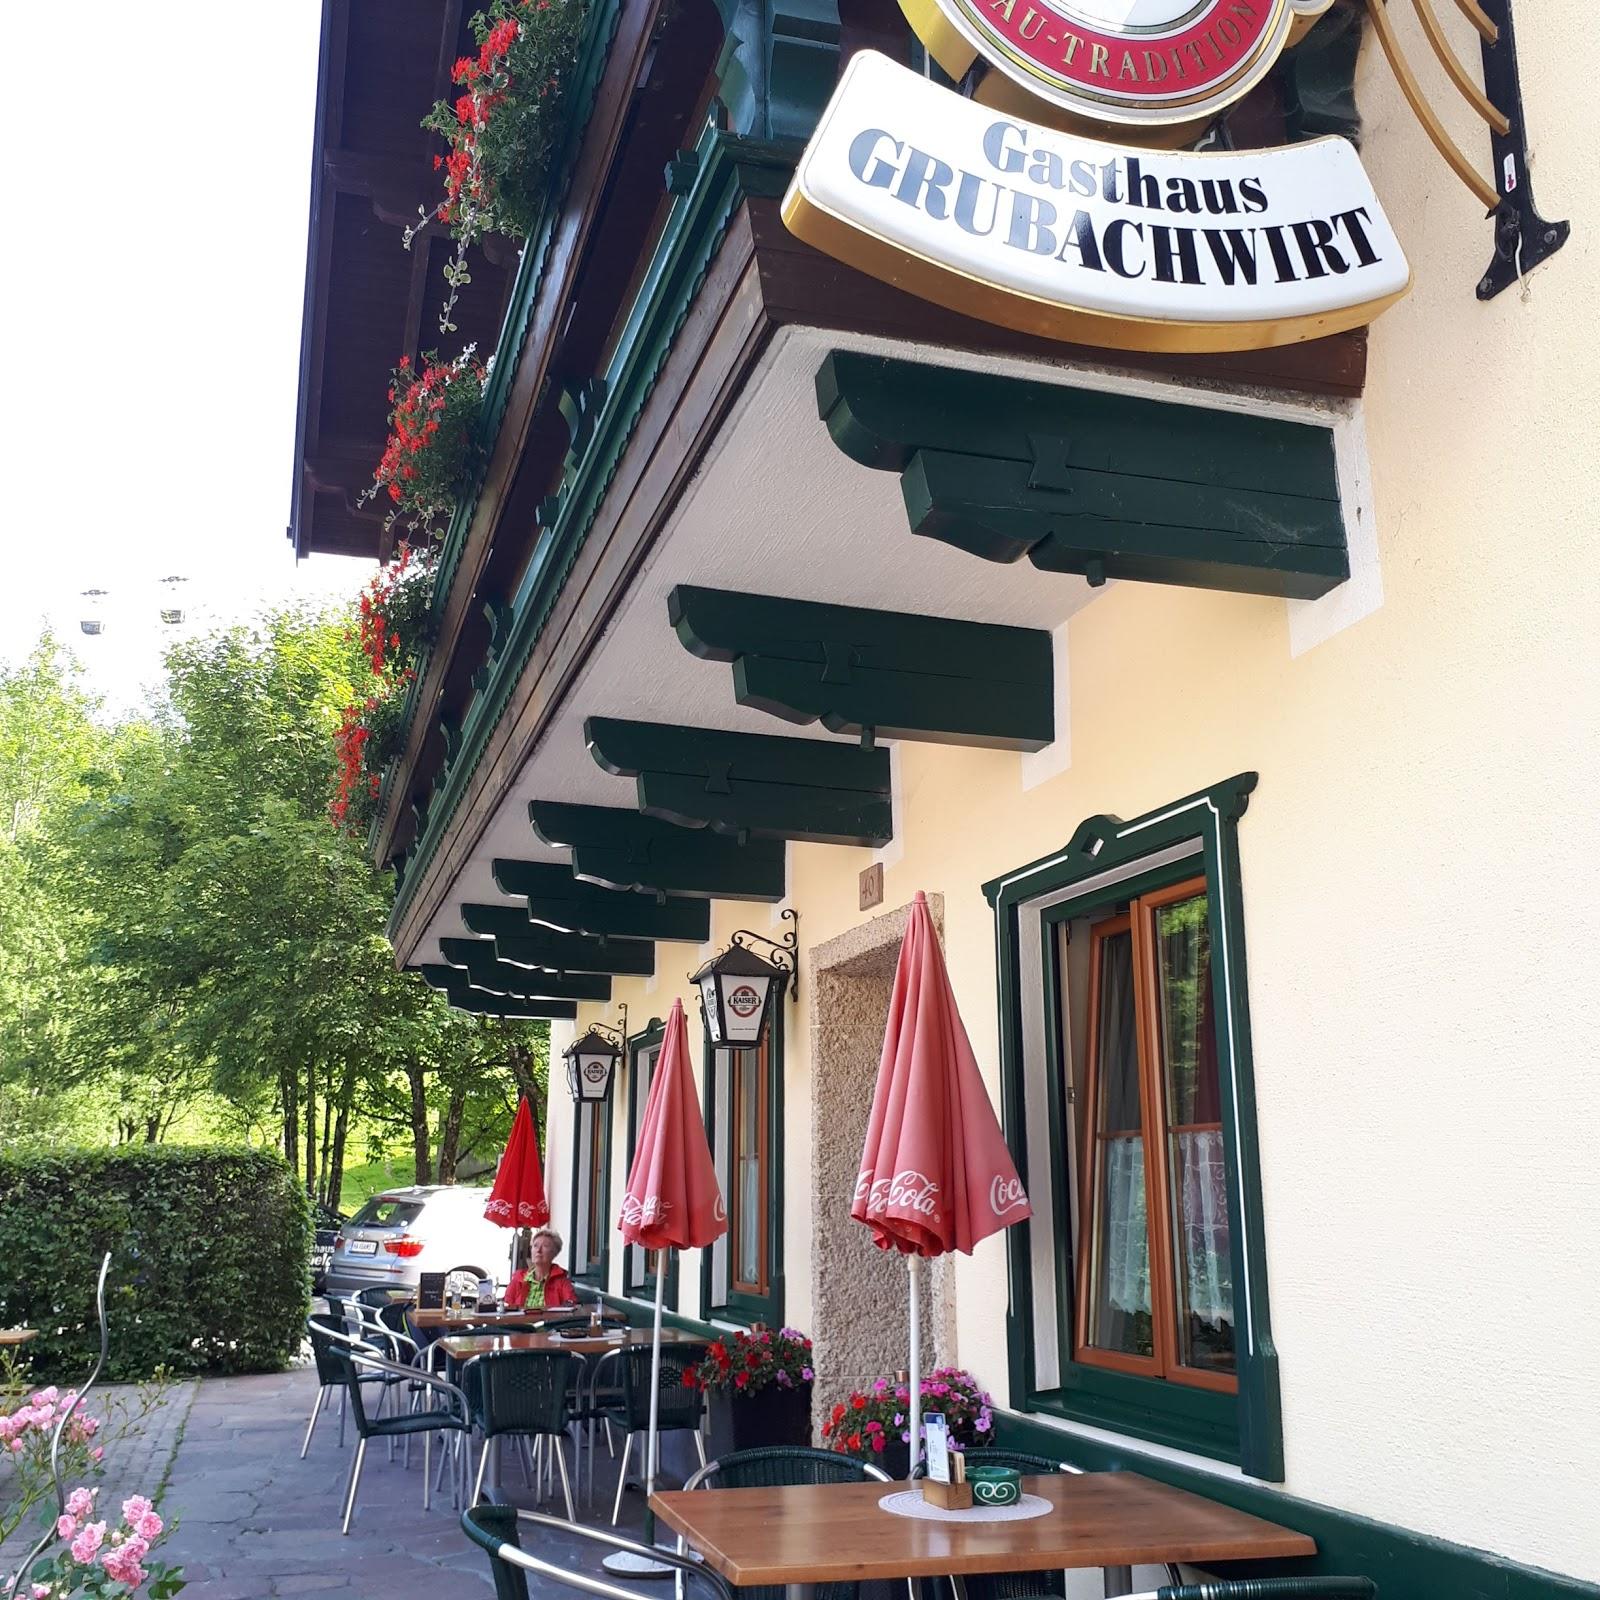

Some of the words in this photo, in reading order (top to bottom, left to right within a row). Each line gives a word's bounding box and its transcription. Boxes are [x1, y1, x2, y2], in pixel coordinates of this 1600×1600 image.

[982, 121, 1269, 215] Gasthaus
[848, 128, 1382, 286] GRUBACHWIRT
[733, 996, 757, 1005] KAISER
[887, 1170, 939, 1216] Cola
